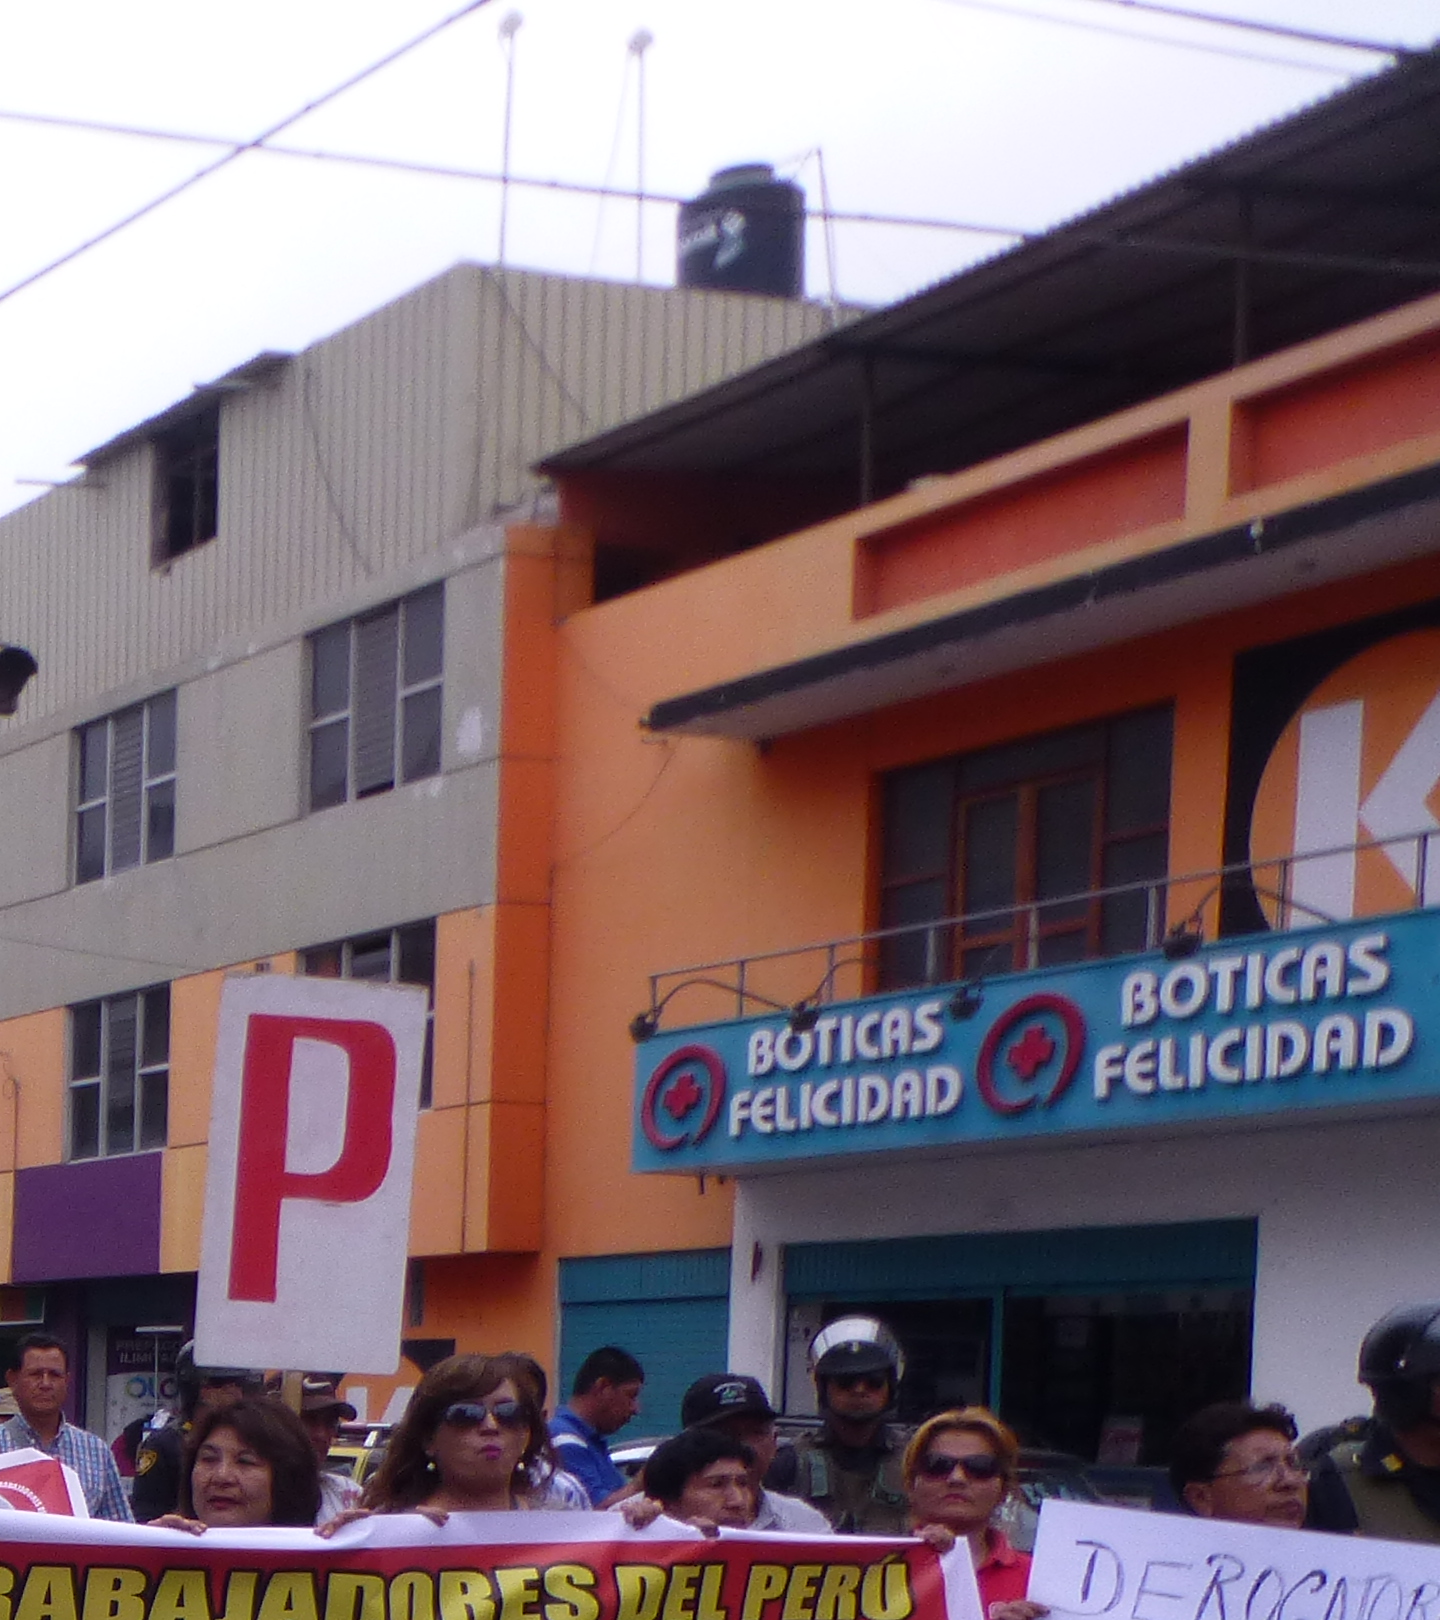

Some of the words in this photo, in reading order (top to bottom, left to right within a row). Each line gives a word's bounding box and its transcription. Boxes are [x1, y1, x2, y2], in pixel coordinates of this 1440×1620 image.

[1121, 933, 1391, 1028] BOTICAS
[748, 1002, 945, 1076] BOTICAS
[1094, 1007, 1414, 1100] FELICIDAD
[728, 1066, 963, 1138] FELICIDAD
[228, 1013, 398, 1303] P
